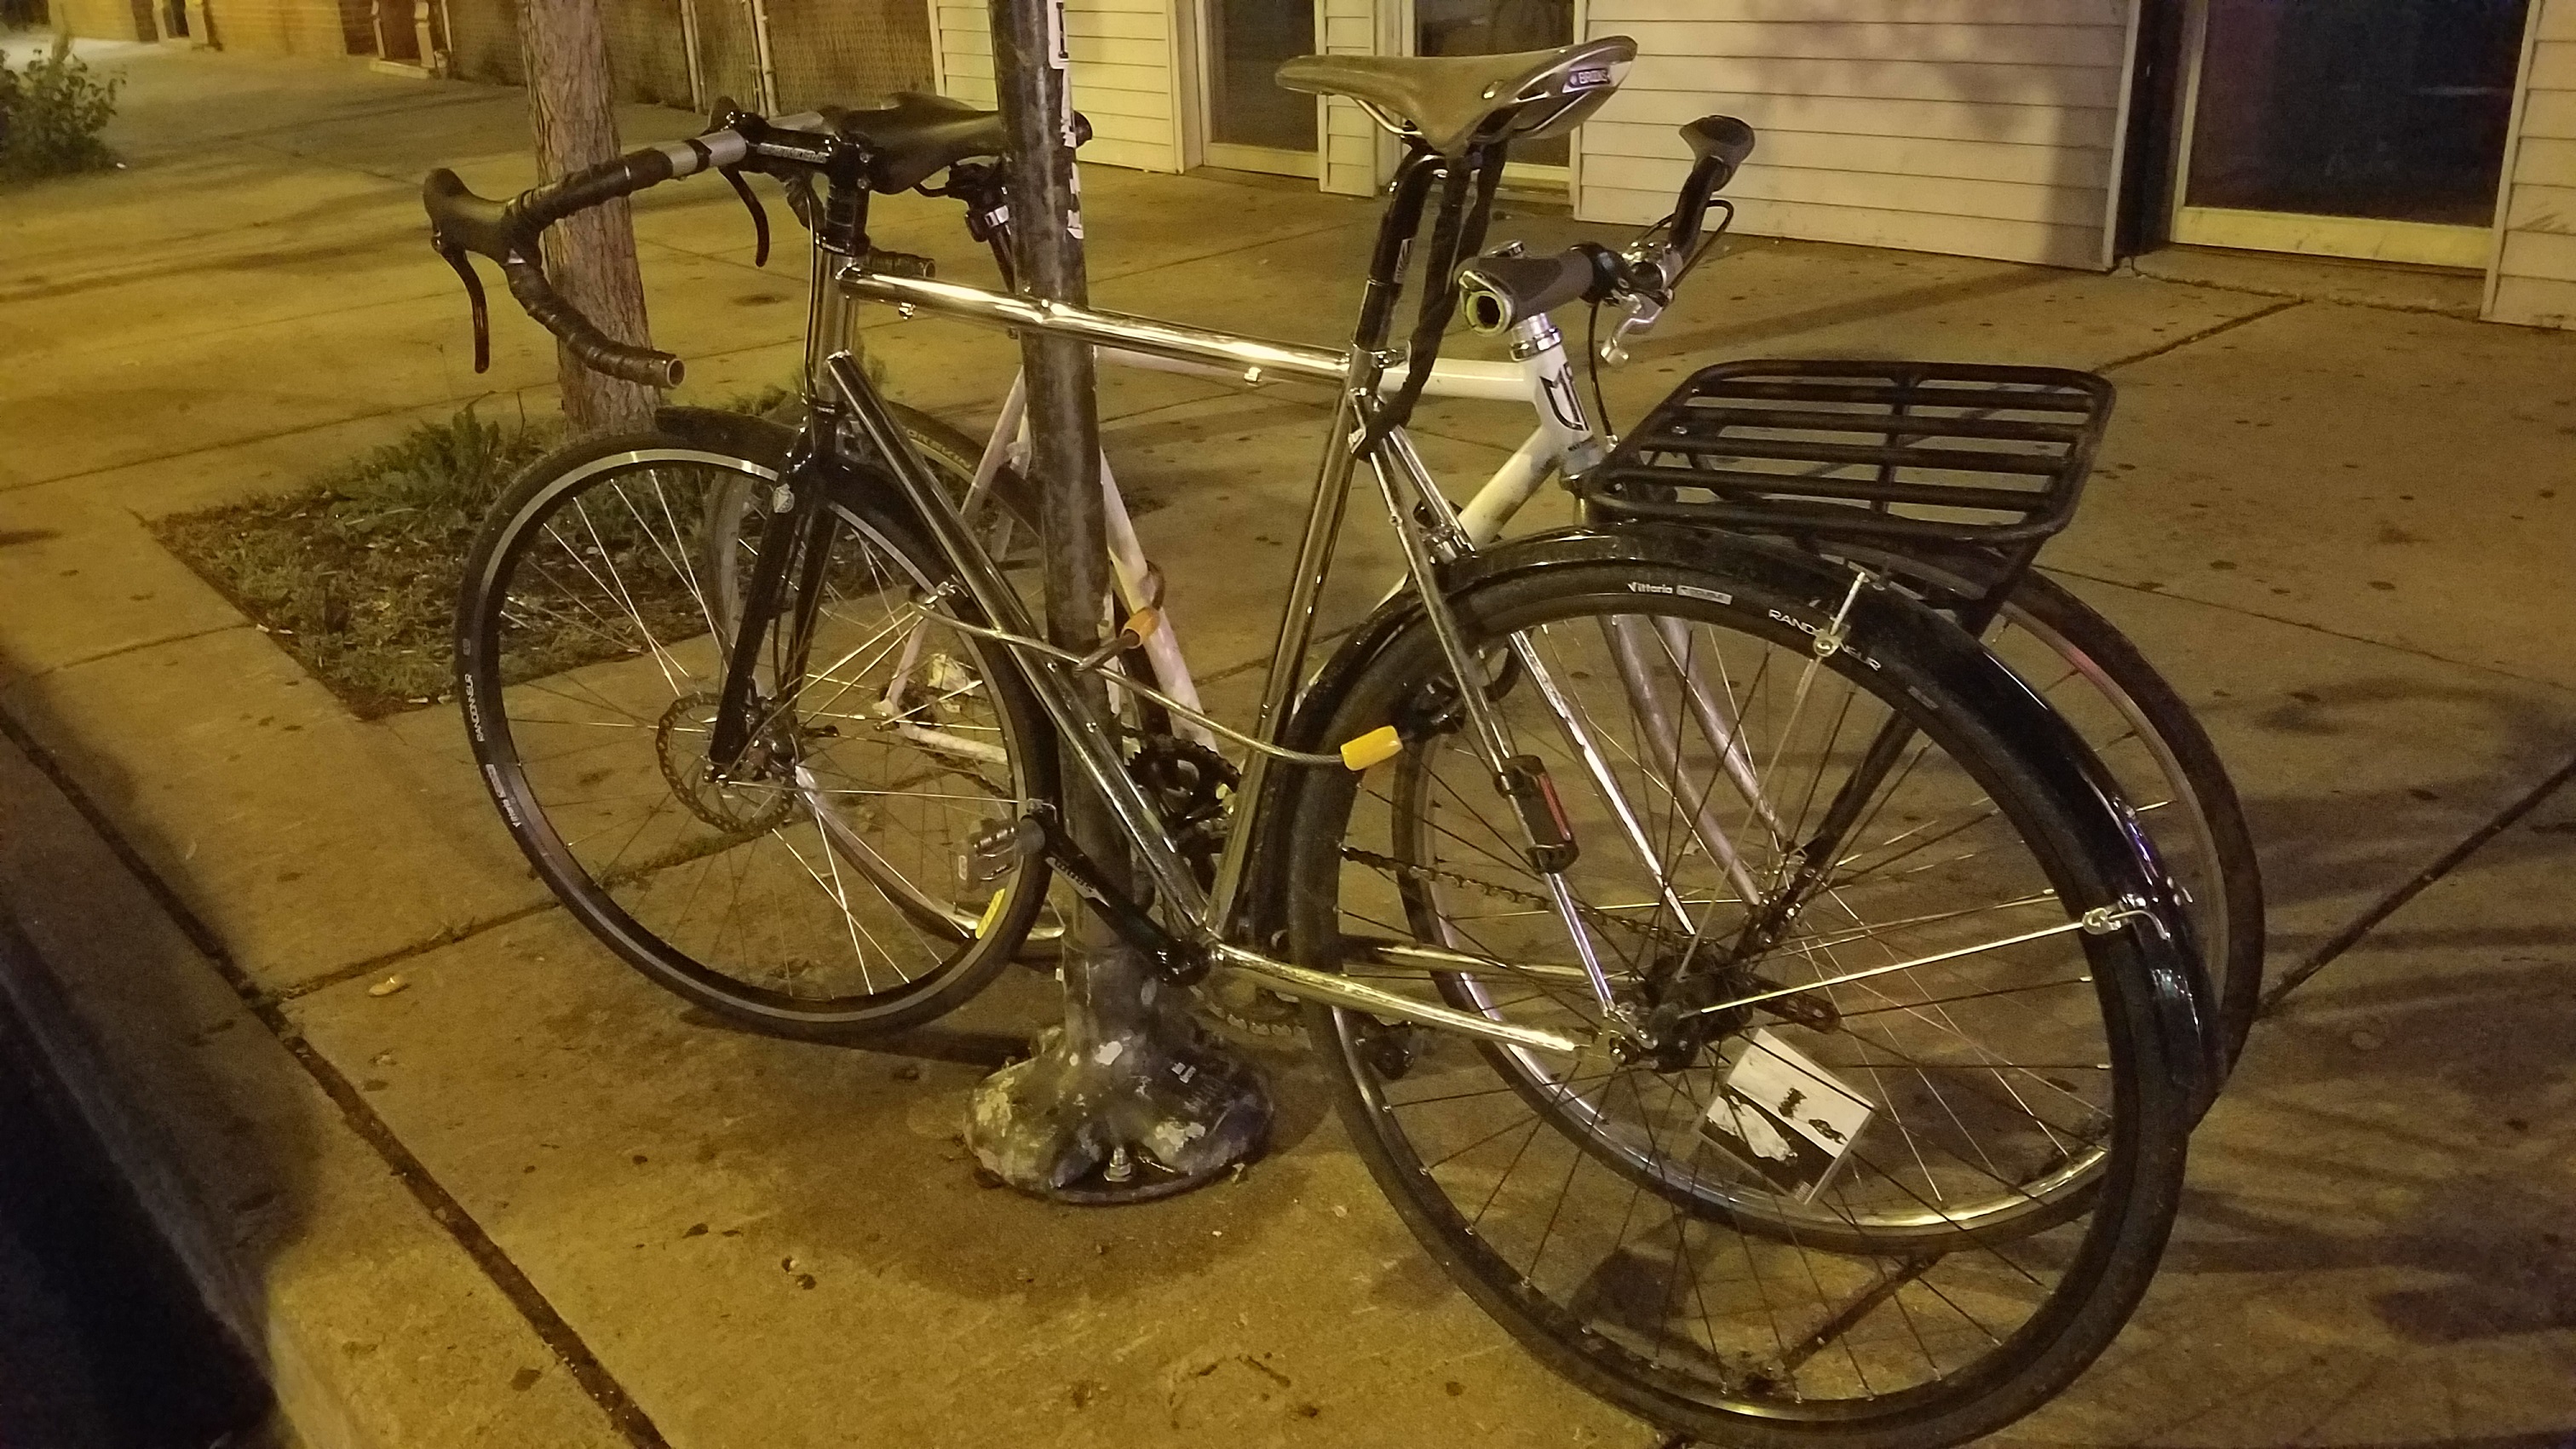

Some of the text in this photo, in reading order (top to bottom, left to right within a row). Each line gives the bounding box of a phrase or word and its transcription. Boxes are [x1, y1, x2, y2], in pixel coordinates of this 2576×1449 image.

[1627, 581, 1673, 594] Vittoria
[1768, 608, 1882, 671] RANDNEUR
[464, 674, 485, 742] RANDONNEUR
